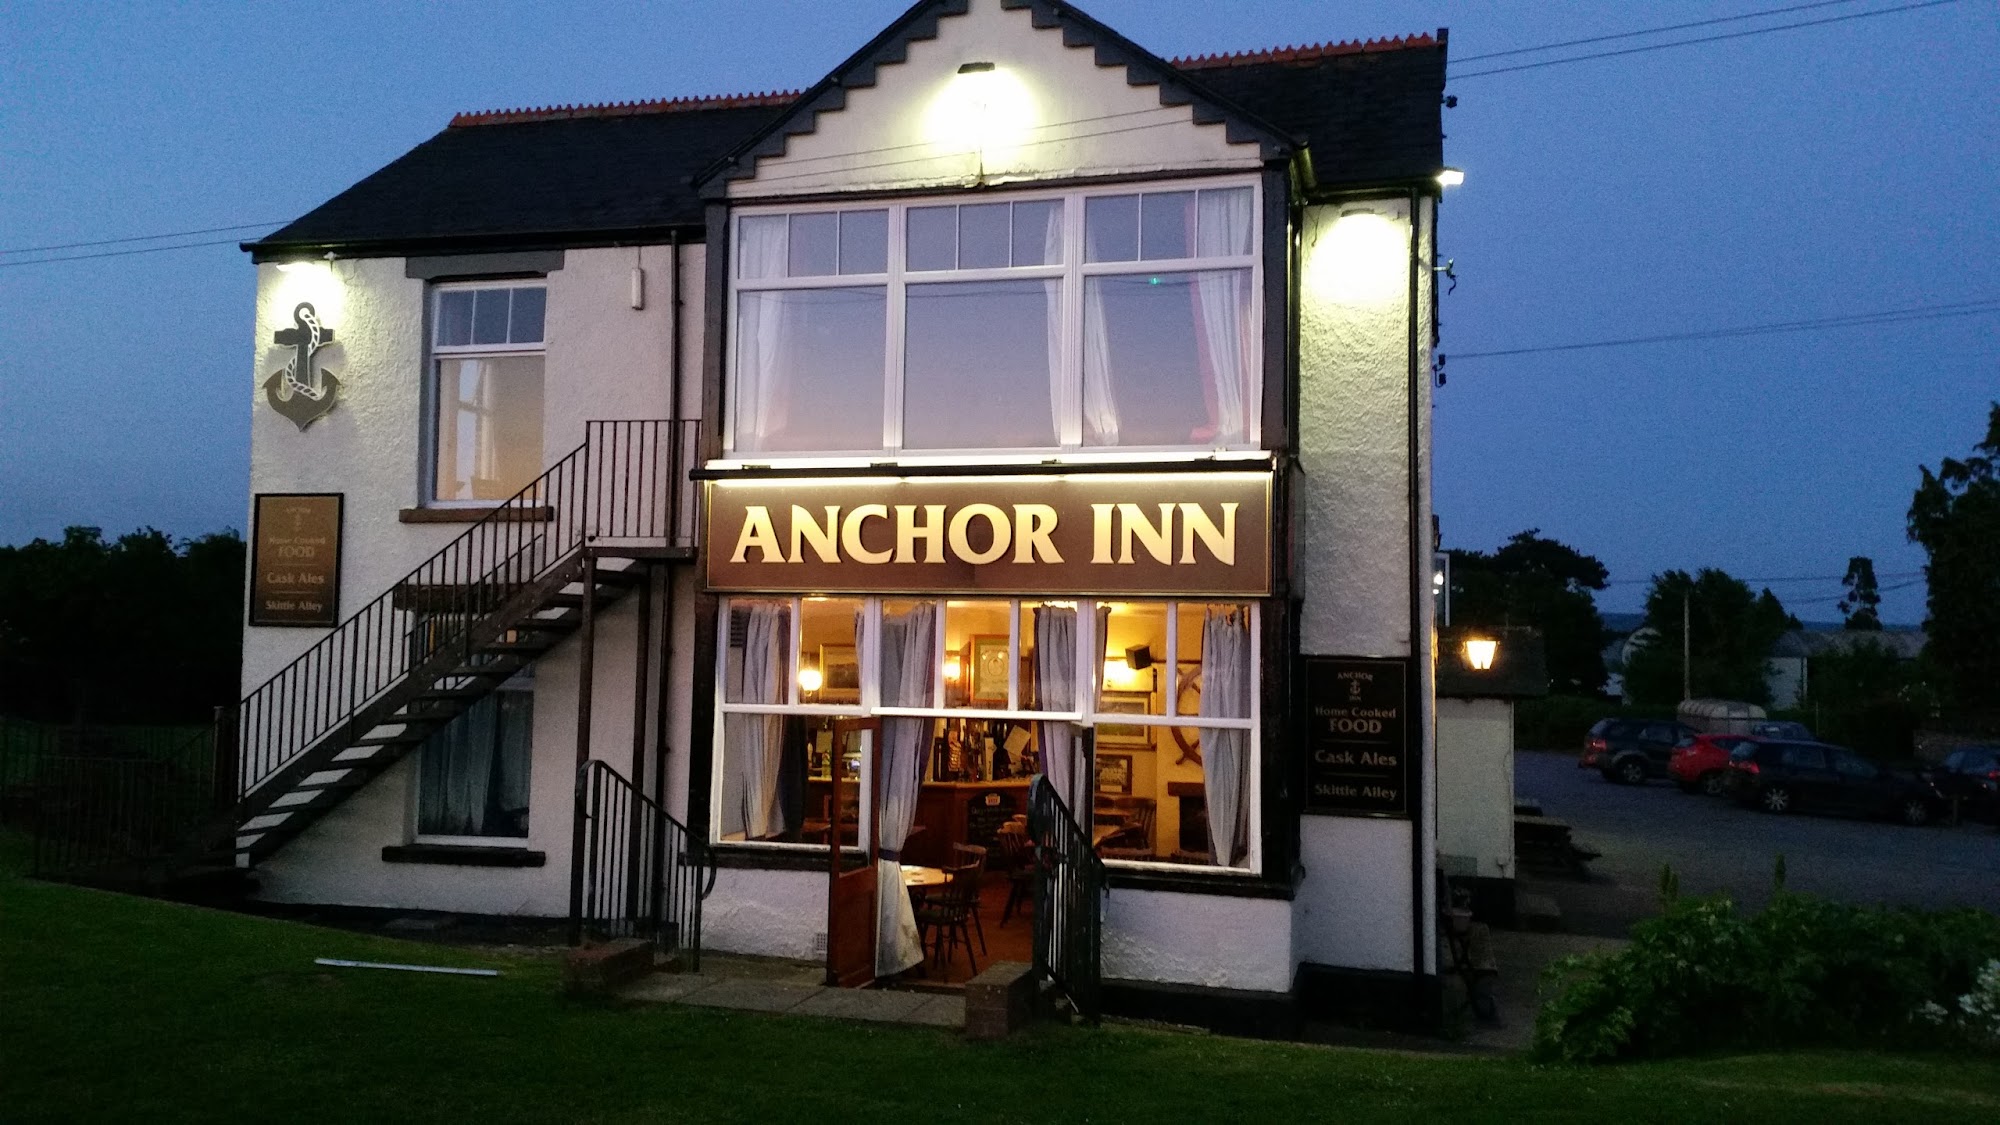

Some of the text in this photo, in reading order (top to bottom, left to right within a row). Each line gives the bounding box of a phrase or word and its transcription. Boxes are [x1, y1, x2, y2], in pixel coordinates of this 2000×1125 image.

[729, 502, 1240, 566] ANCHOR INN
[267, 572, 325, 584] Cask Ales
[265, 600, 323, 613] Skittle Alley
[1337, 671, 1373, 682] ANCHOR
[1315, 706, 1397, 718] Home Cooked
[1329, 718, 1382, 734] FOOD
[1315, 749, 1397, 767] Cask Ales
[1315, 784, 1397, 801] Skittle Alley
